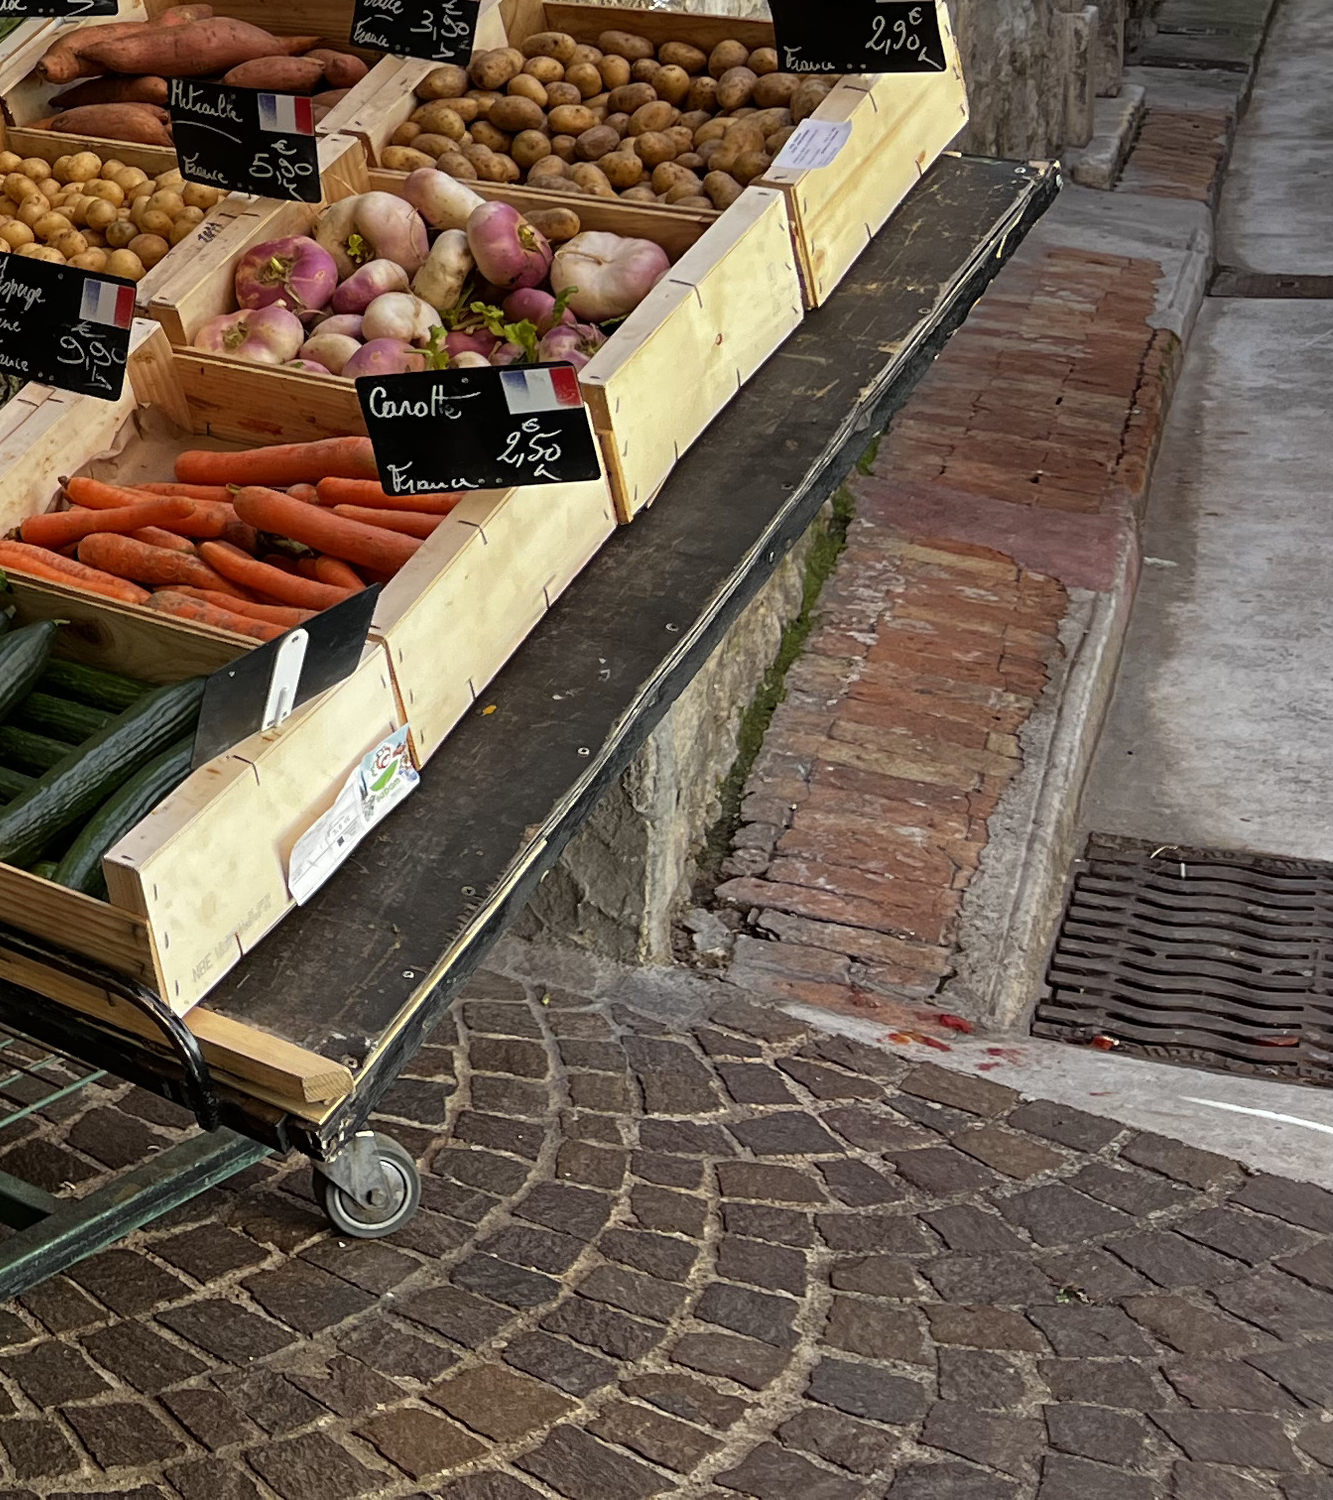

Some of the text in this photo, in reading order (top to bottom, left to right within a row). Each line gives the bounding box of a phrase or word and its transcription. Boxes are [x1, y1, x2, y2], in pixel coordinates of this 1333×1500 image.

[864, 15, 921, 55] 2,90
[248, 153, 313, 185] 5,90
[496, 429, 563, 468] 2,50
